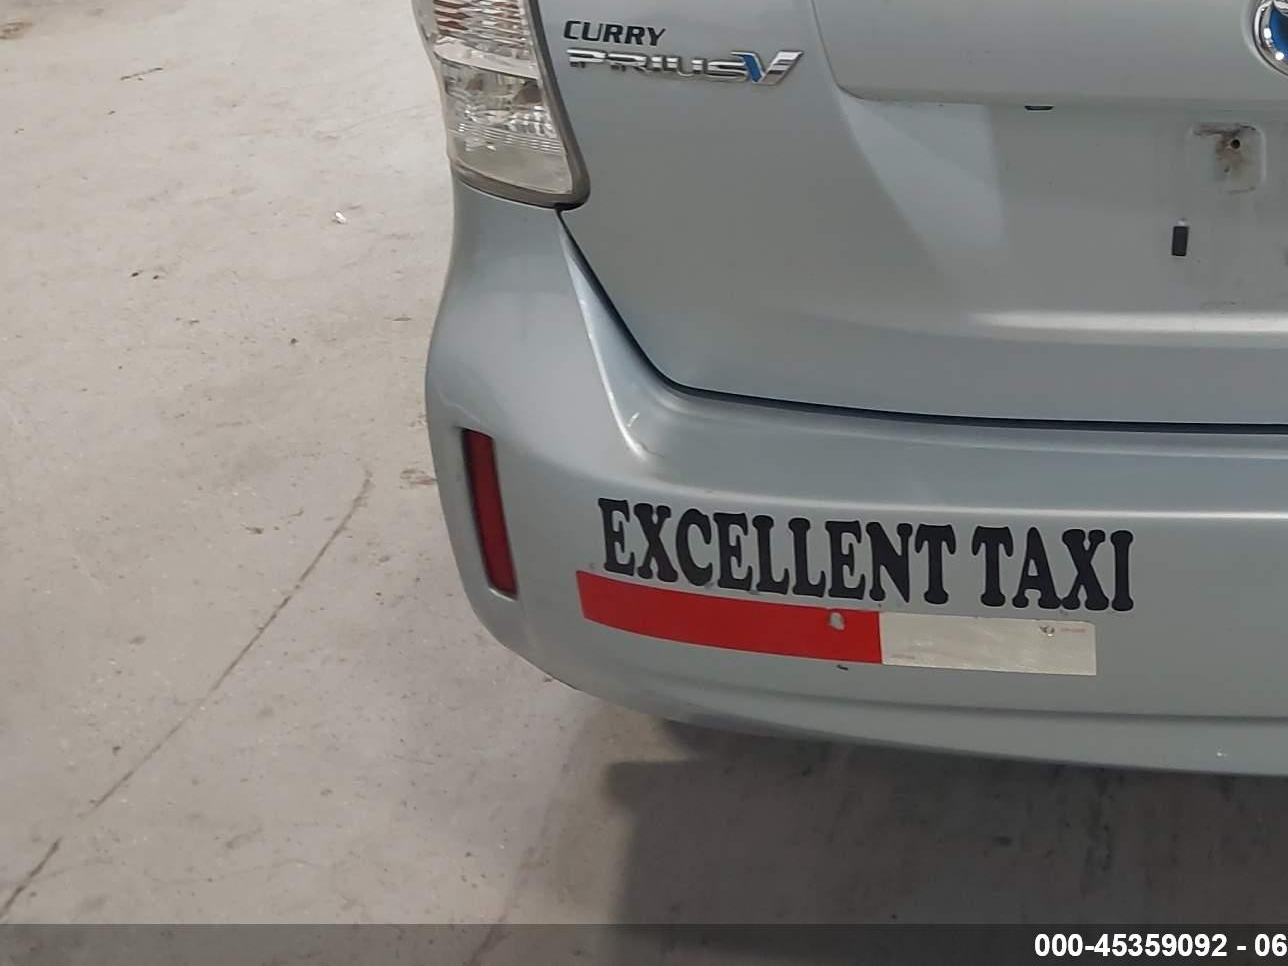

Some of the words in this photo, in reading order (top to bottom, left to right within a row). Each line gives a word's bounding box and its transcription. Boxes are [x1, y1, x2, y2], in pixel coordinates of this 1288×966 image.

[563, 20, 667, 47] CURRY
[597, 497, 957, 605] EXCELLENT
[971, 525, 1135, 613] TAXI
